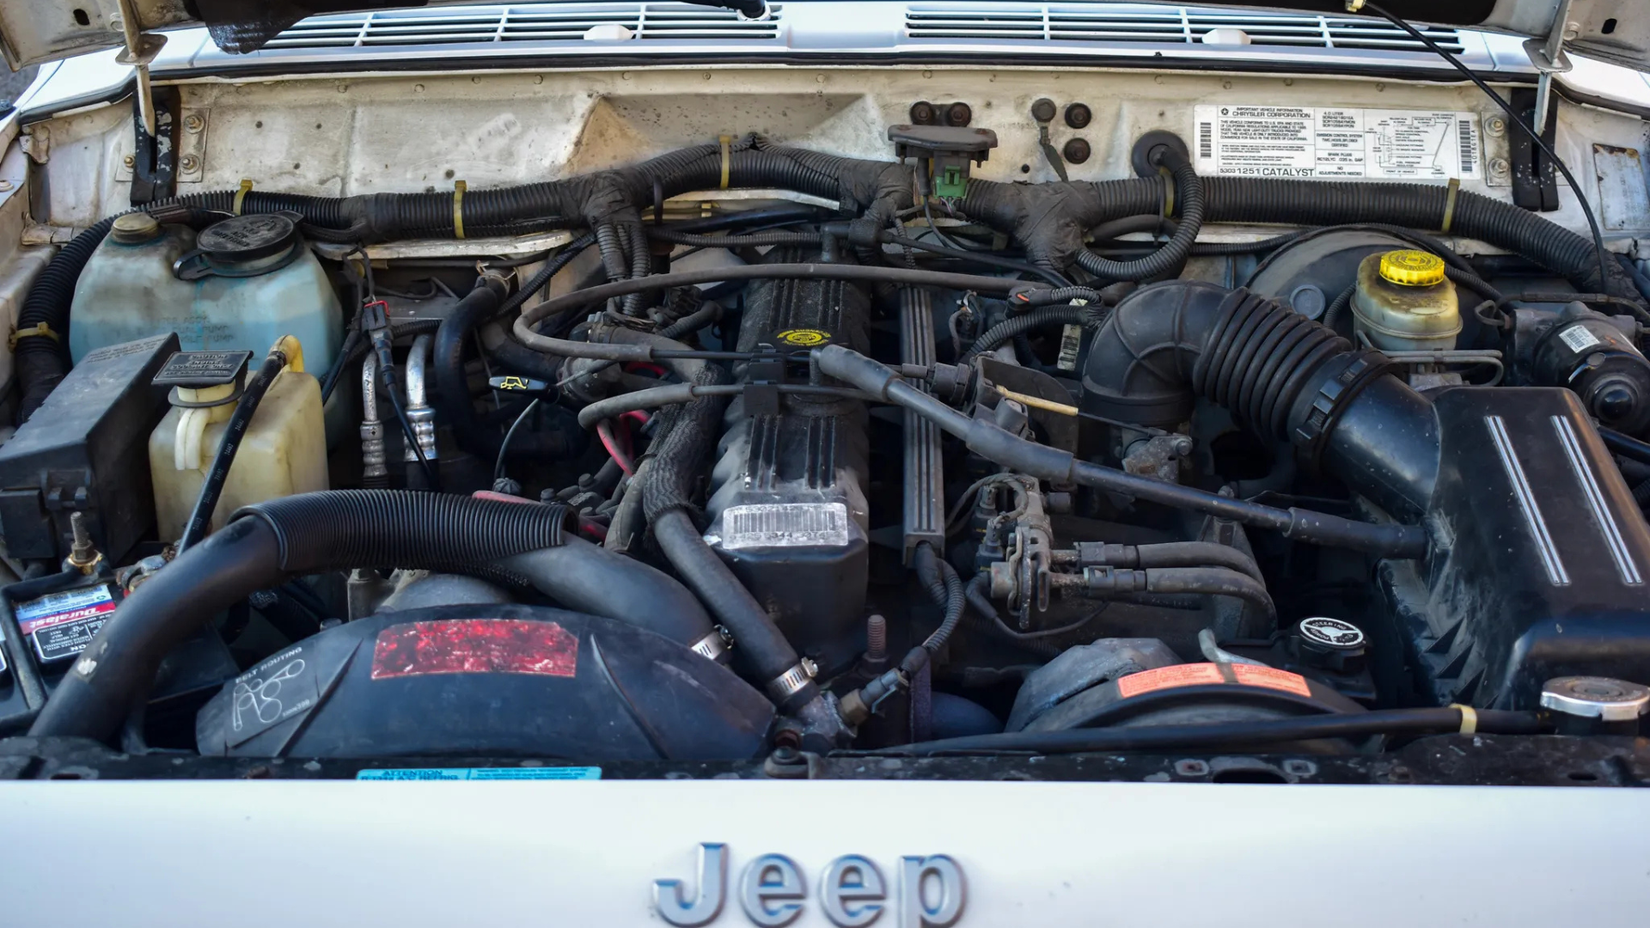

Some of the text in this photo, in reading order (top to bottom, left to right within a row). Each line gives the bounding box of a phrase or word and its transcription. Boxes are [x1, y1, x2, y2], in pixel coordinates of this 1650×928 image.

[1262, 168, 1314, 176] CATALYST
[29, 608, 100, 628] Duralast
[236, 647, 302, 683] BELT ROUTING
[652, 842, 968, 928] Jeep
